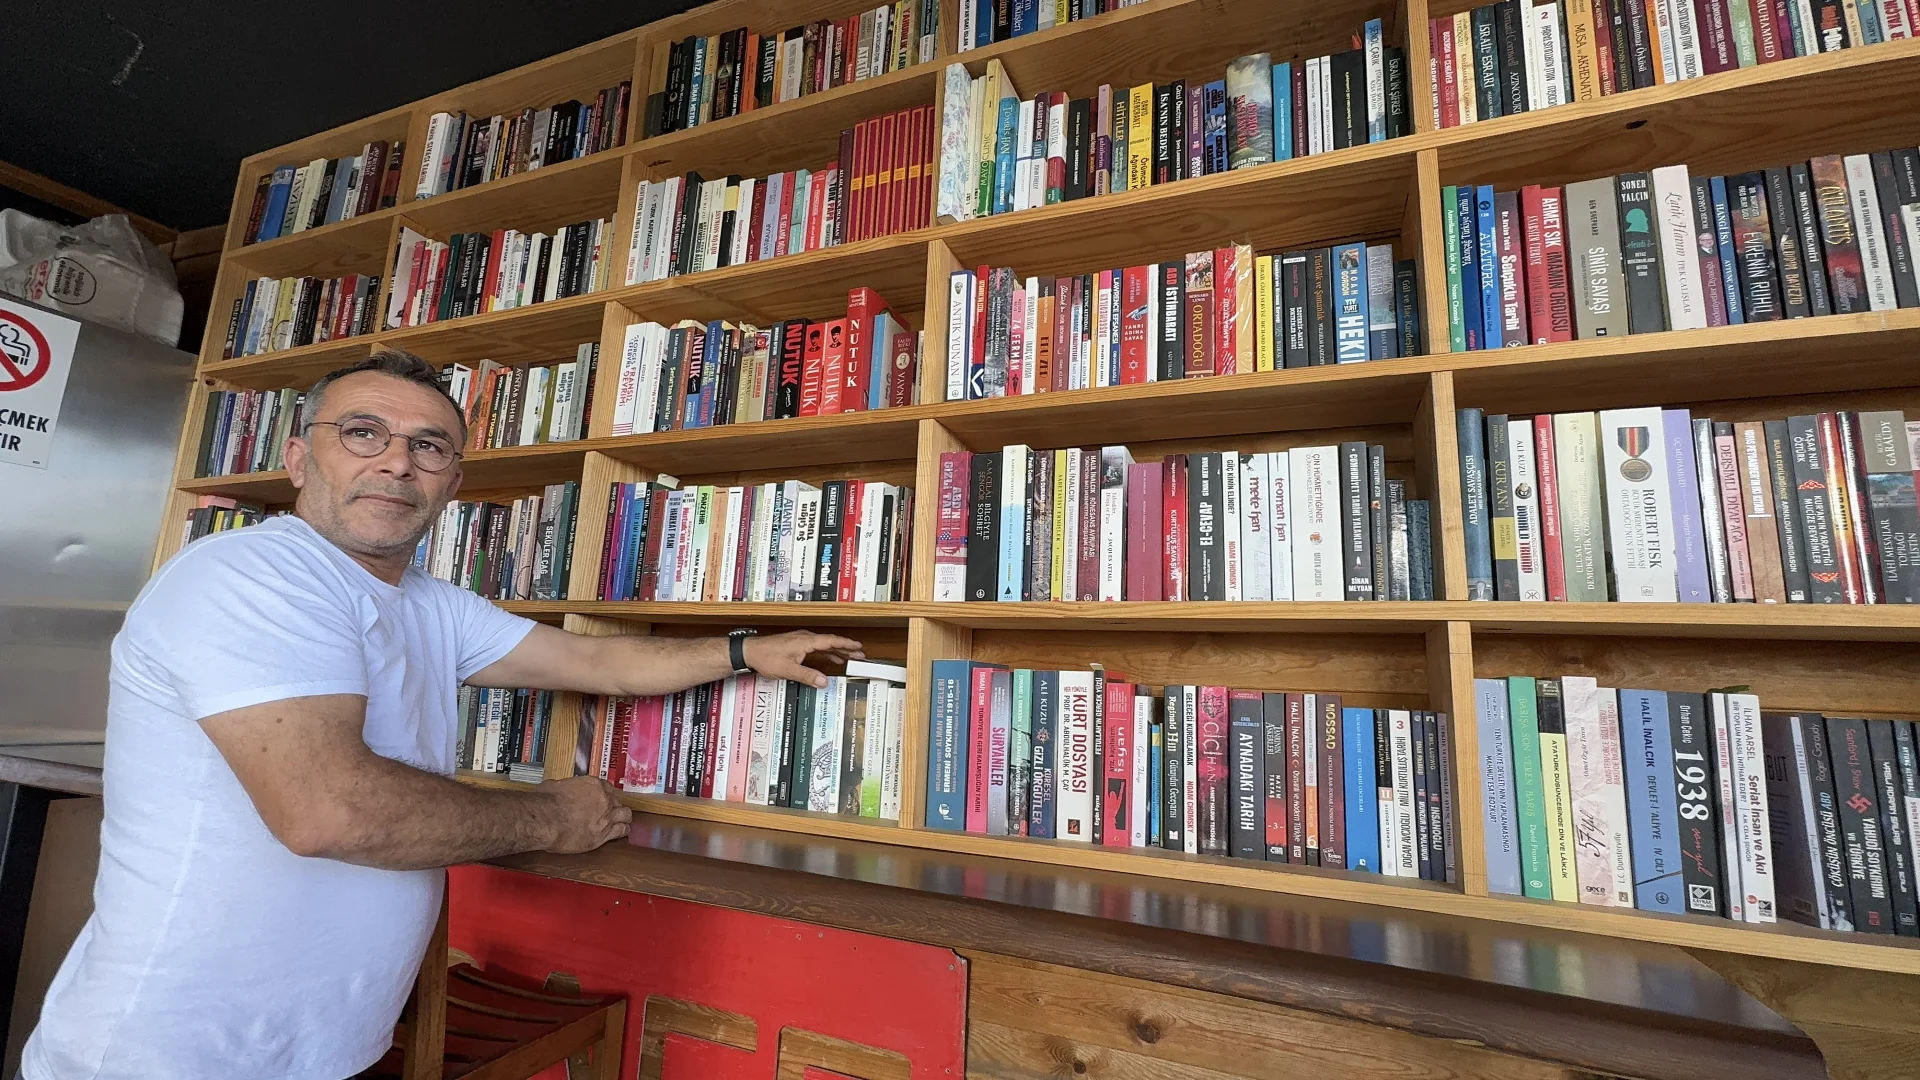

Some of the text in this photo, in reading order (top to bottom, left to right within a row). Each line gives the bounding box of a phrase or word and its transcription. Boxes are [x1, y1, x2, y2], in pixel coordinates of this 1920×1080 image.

[1540, 11, 1549, 19] 2
[1478, 24, 1494, 88] İSRAİL ESRARI
[1630, 15, 1646, 72] İnanılmaz Öyküsü
[1000, 105, 1013, 154] TOMRİS HAN
[1049, 117, 1060, 146] ATATÜRK
[1115, 101, 1125, 142] HİTİTLER
[1159, 93, 1170, 161] İSA'NIN BEDENİ
[980, 134, 991, 186] MAYO CLINIC
[1130, 154, 1139, 183] Ağındaki
[1139, 157, 1148, 187] Örümcek
[1588, 199, 1597, 210] BEN
[1621, 180, 1646, 191] SONER
[1621, 191, 1649, 202] YALÇIN
[1799, 191, 1811, 224] MUSA'NIN
[1805, 226, 1819, 262] MÜCAHİTİ
[52, 260, 66, 294] ekonomik
[1341, 271, 1349, 296] GORDON
[1350, 269, 1358, 295] NOAH
[1479, 232, 1494, 289] ATATÜRK
[1540, 198, 1569, 332] AHMET ŞIK İMAMIN ORDUSU
[1588, 247, 1609, 275] SİNİR
[1742, 232, 1774, 315] EVRENİN RUHU
[1589, 278, 1610, 315] SAVAŞI
[689, 336, 704, 378] NUTUK
[781, 323, 802, 386] NUTUK
[846, 319, 861, 388] NUTUK
[951, 300, 964, 376] ANTİK YUNAN
[1010, 318, 1021, 371] 74. FERMAN
[1192, 305, 1205, 367] ORTADOĞU
[802, 358, 820, 408] NUTUK
[824, 354, 842, 405] NUTUK
[0, 433, 22, 452] IR
[1515, 440, 1525, 476] ALİ KUZU
[1803, 428, 1820, 470] YAŞAR NURİ
[1880, 419, 1897, 466] GARAUDY
[940, 461, 953, 530] GİZLİ TARİHİ
[1089, 472, 1097, 493] İNALCIK
[1312, 453, 1324, 523] ÇİN HÜKMETTİĞİNDE
[1349, 453, 1363, 552] CUMHURİYET TARİHİ YALANLARI
[1465, 454, 1479, 525] ADALET SAVAŞÇISI
[1718, 444, 1743, 544] DERSİMLİ DİYAP AĞA
[1088, 529, 1096, 557] AVRUPASI
[1169, 509, 1177, 544] KURTULUŞ
[1199, 502, 1213, 546] EL-CEVAP
[1225, 459, 1237, 589] GÜÇ KİMİN ELİNDE? NOAM CHOMSKY
[1516, 505, 1532, 574] DONALD TRUMP
[1642, 488, 1662, 569] ROBERT FISK
[1803, 498, 1822, 564] MUCİZE DEVRİMLER
[1813, 495, 1833, 566] KUR'AN'IN YARATTIĞI
[775, 550, 786, 582] GIBBINS
[1574, 543, 1584, 573] ULUSAL
[1582, 538, 1596, 590] DEMOKRATİK
[1894, 531, 1909, 568] TOPRAĞI
[754, 691, 767, 738] İZİNDE
[1186, 693, 1194, 722] GELECEĞİ
[1396, 720, 1404, 729] 3
[696, 722, 706, 750] DARWIN
[943, 679, 954, 793] ERMENİ SOYKIRIMI 1915-16
[991, 727, 1005, 786] SÜRYANİLER
[1072, 694, 1088, 793] KÜRT DOSYASI
[1116, 726, 1127, 773] isyan
[1167, 696, 1179, 818] Reginald Hill Günaydın Geceyarısı
[1743, 708, 1755, 761] İLHAN ARSEL
[1845, 729, 1859, 761] Stanford
[696, 751, 704, 771] TANRI
[1239, 732, 1254, 831] AYNADAKİ TARİH
[1851, 769, 1861, 789] Shaw
[1032, 746, 1044, 825] GİZLİ ÖRGÜTLER
[1043, 768, 1052, 802] KÜRESEL
[1186, 781, 1194, 800] NOAM
[1808, 723, 1842, 887] ÇÖKÜŞÜN ÖNCÜSÜ ABD Roger Garaudy
[1186, 801, 1194, 833] CHOMSKY
[1488, 796, 1496, 823] BOZKURT
[1847, 832, 1865, 879] ve TÜRKİYE
[1862, 817, 1885, 898] YAHUDİ SOYKIRIMI
